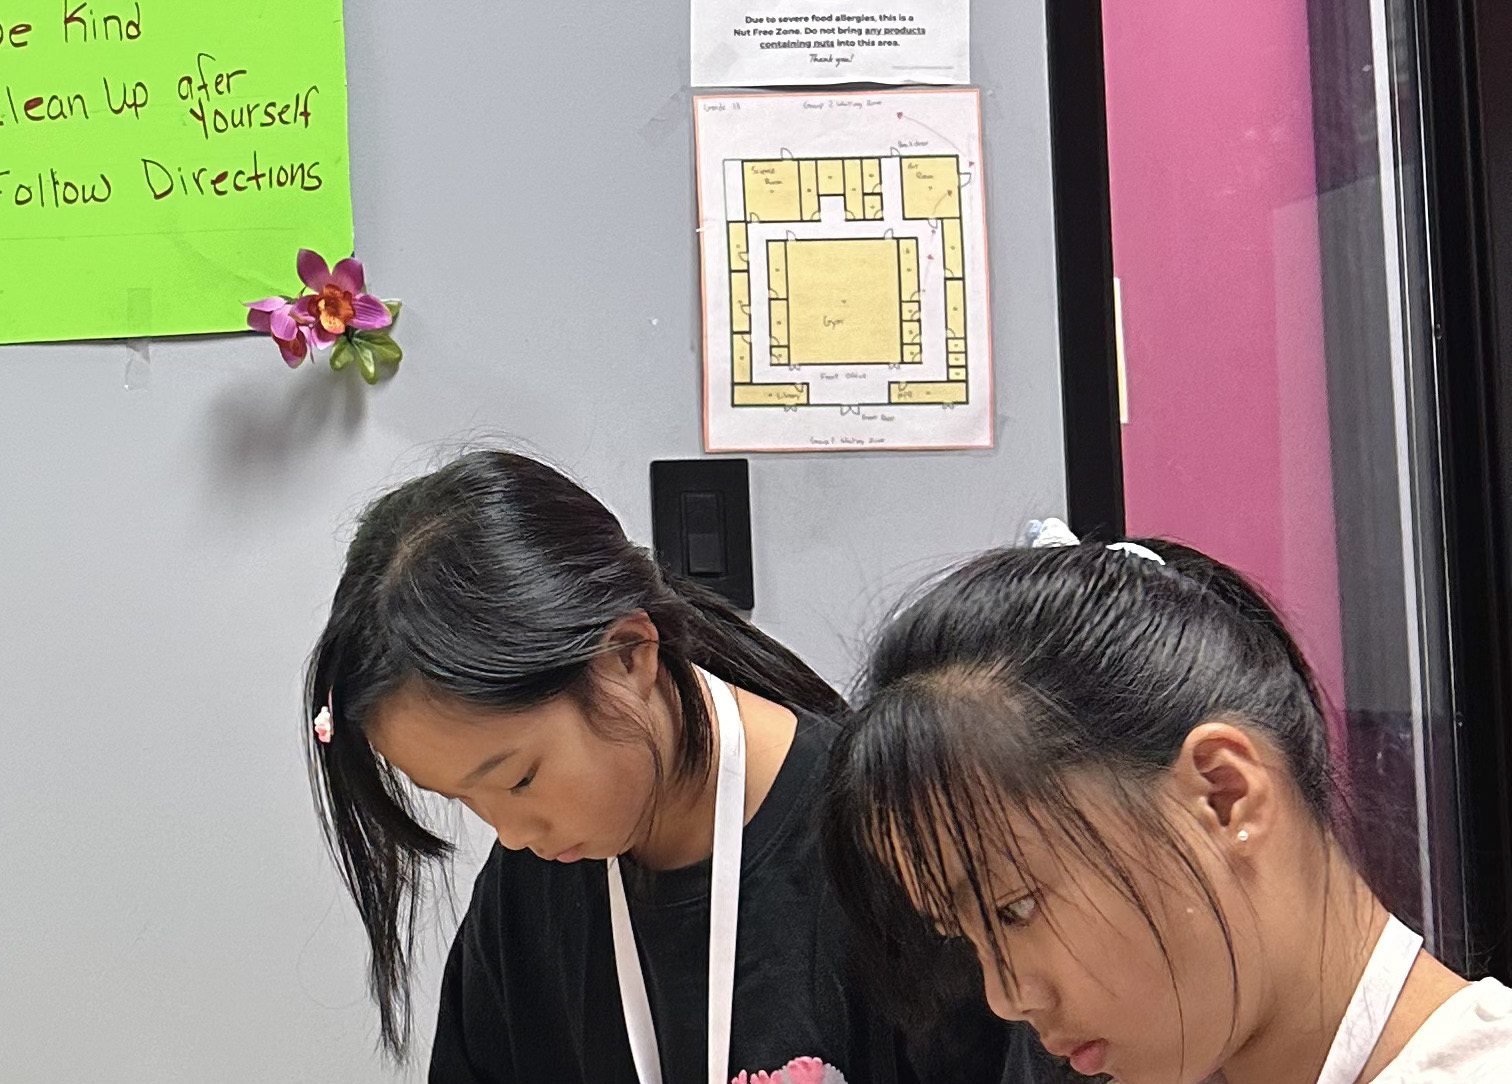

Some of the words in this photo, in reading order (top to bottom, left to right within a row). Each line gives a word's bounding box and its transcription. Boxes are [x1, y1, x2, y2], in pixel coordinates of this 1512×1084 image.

[64, 0, 142, 43] Kind
[745, 16, 764, 24] Due
[811, 14, 833, 22] food
[879, 14, 896, 22] this
[753, 28, 774, 36] Free
[804, 27, 818, 35] Do
[838, 26, 862, 36] bring
[884, 26, 926, 36] products
[760, 40, 811, 49] containing
[837, 39, 855, 47] into
[857, 39, 875, 47] this
[141, 151, 322, 200] Directions
